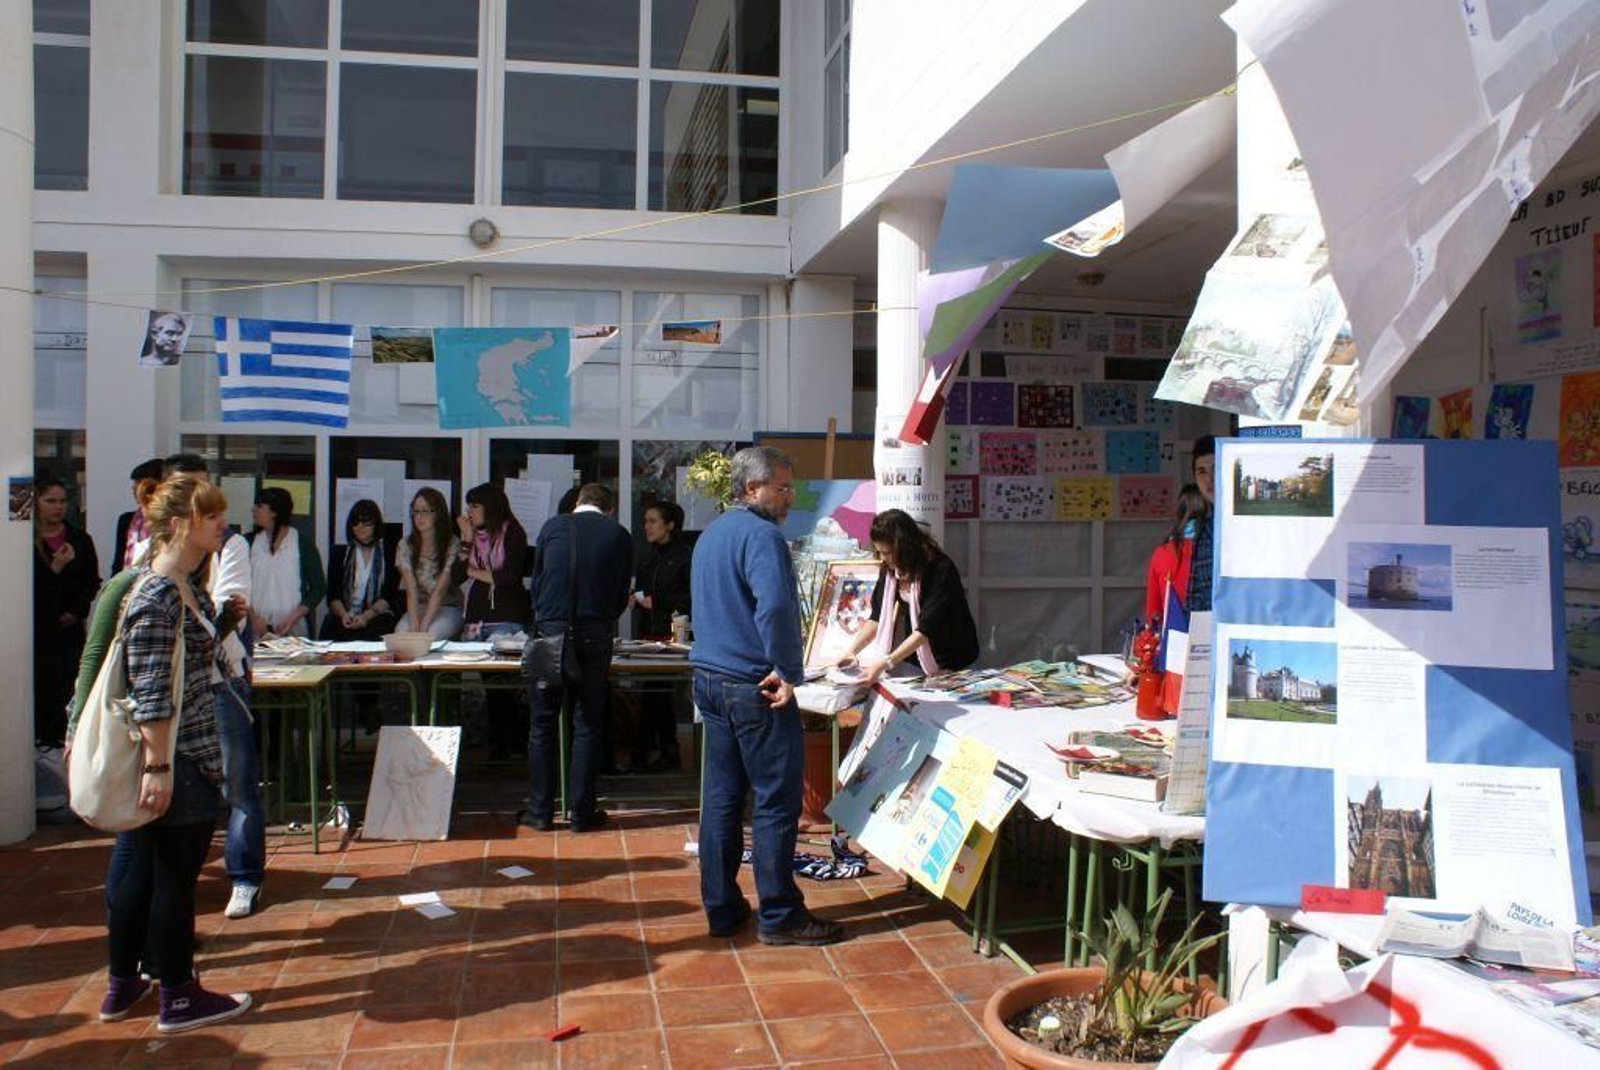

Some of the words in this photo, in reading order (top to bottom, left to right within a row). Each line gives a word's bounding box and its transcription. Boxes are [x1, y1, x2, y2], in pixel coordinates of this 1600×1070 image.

[1545, 189, 1565, 208] BD
[1510, 902, 1531, 917] PAYS
[1530, 912, 1543, 922] DE
[1543, 918, 1554, 927] LA
